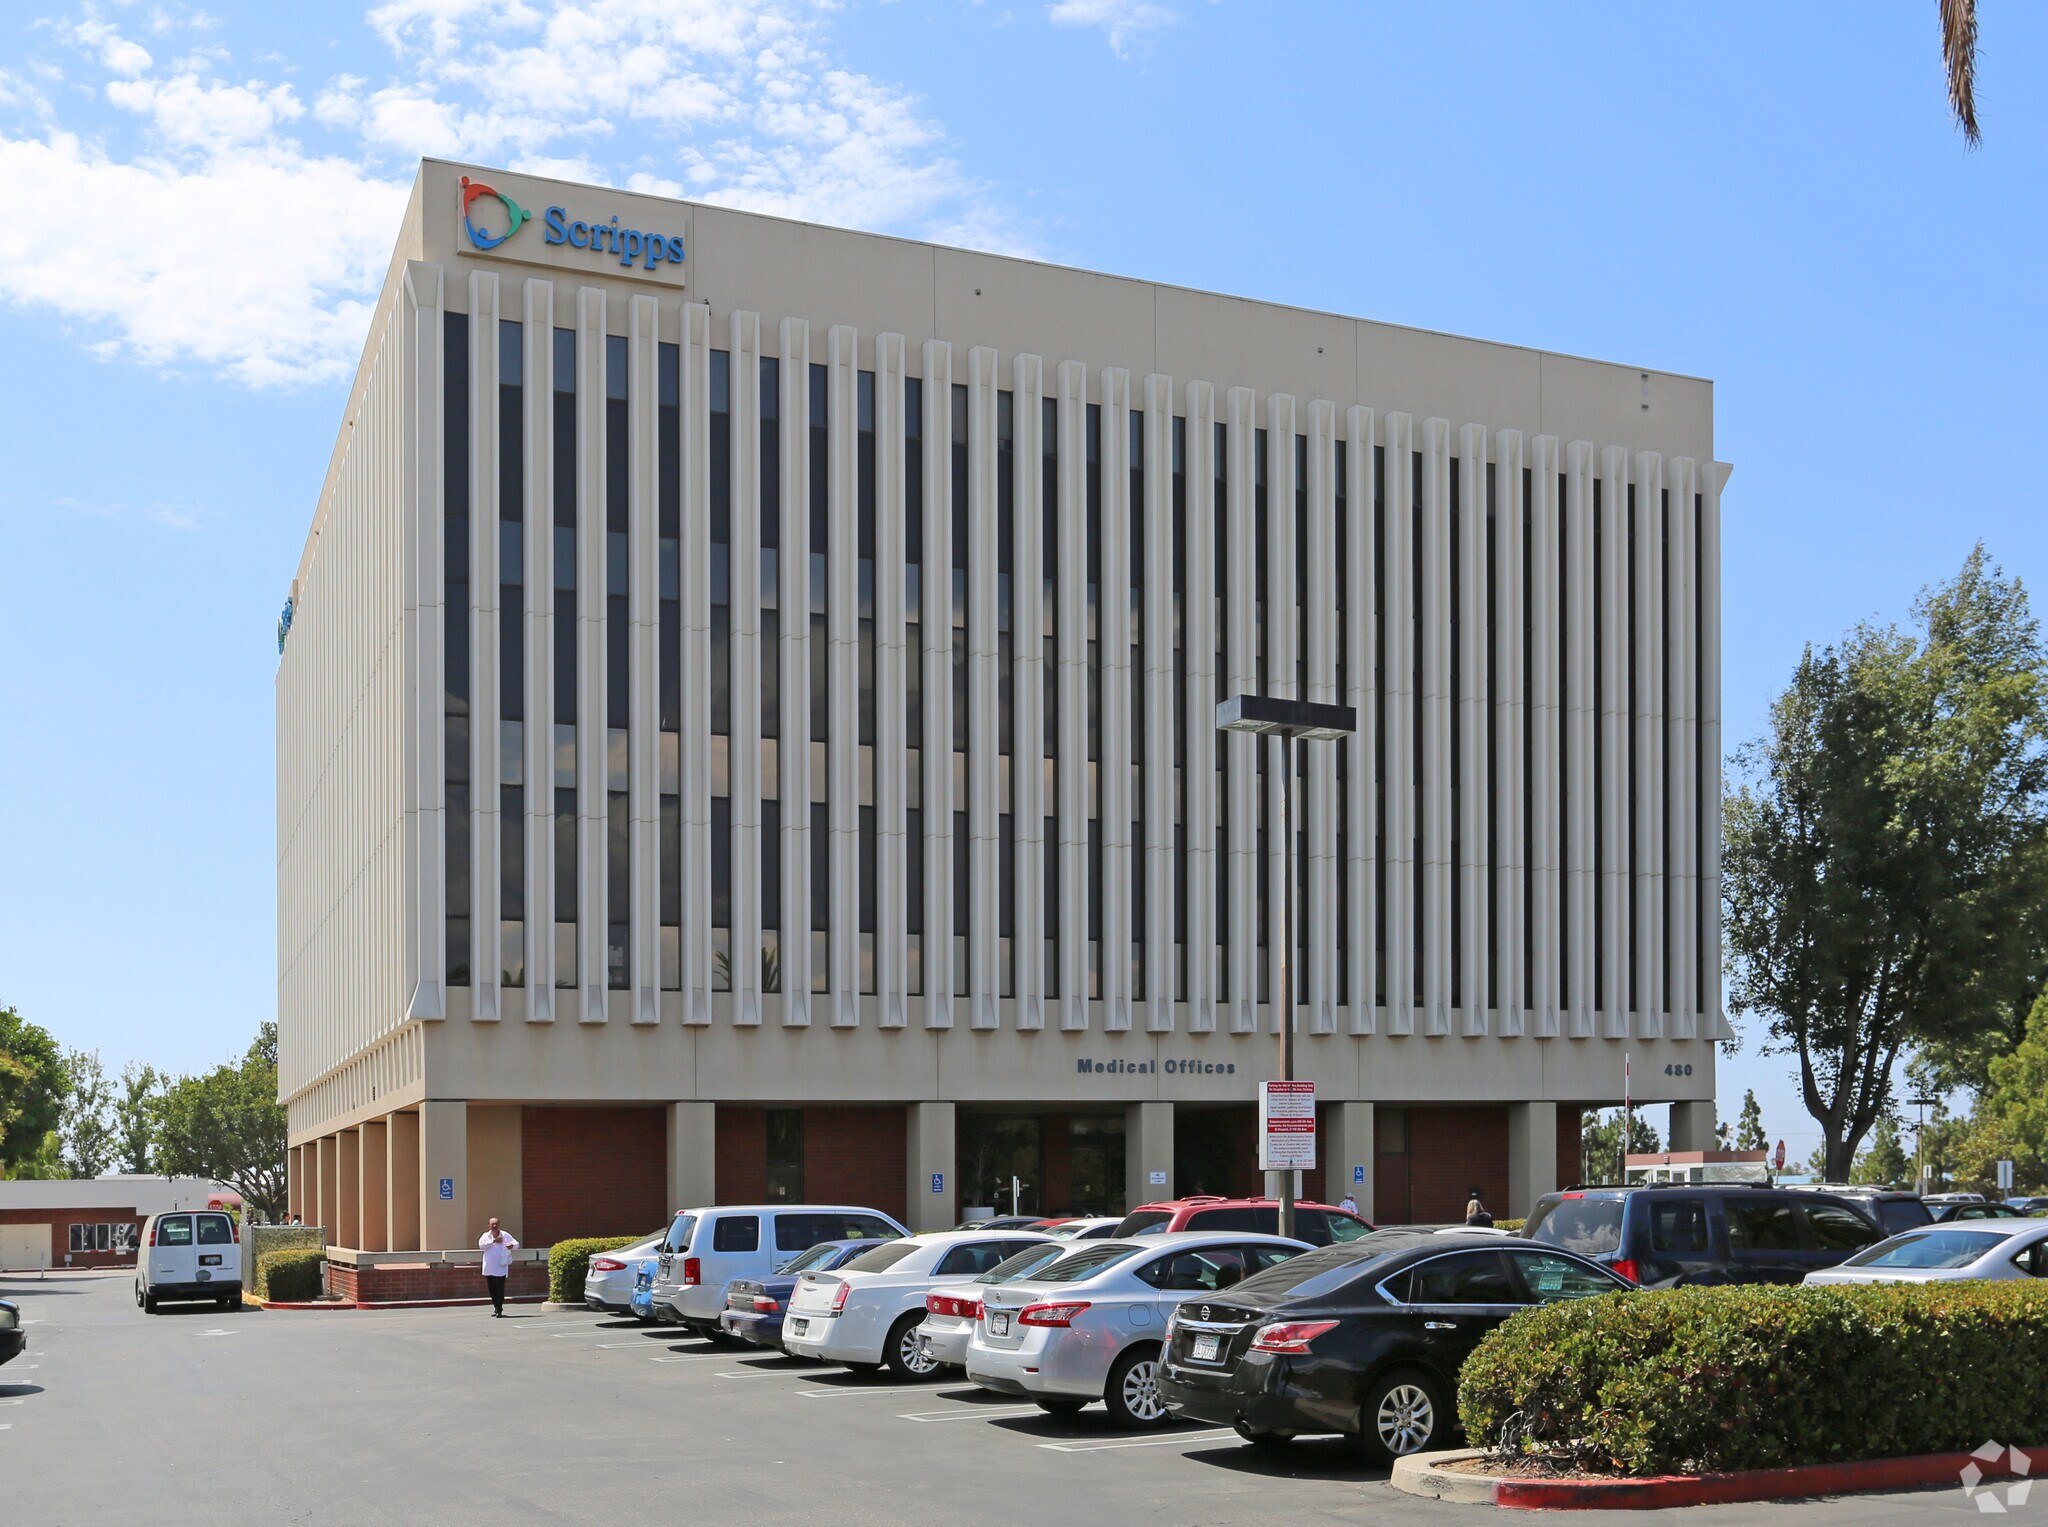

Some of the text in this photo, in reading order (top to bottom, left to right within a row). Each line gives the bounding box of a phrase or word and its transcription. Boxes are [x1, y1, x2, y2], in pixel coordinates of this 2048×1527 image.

[544, 206, 685, 270] Scripps
[1077, 1059, 1235, 1074] Medical Offices
[1664, 1064, 1692, 1076] 480
